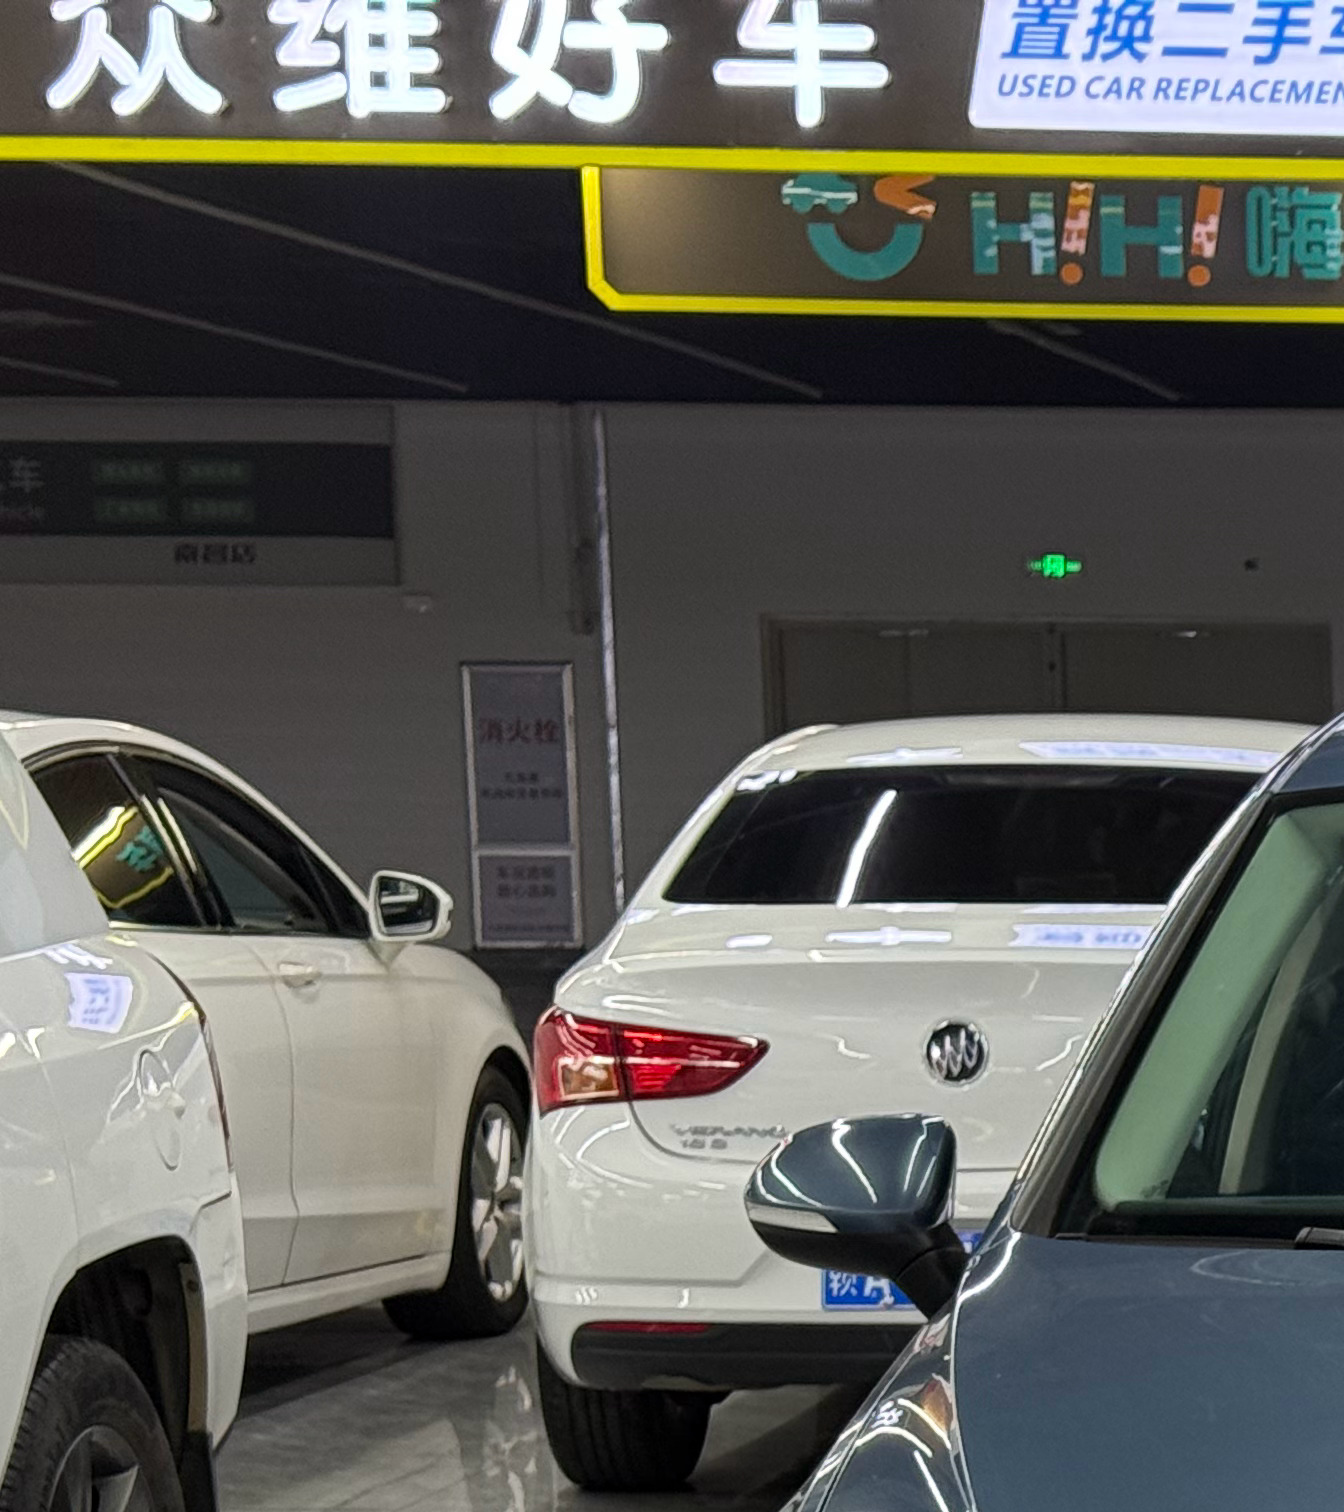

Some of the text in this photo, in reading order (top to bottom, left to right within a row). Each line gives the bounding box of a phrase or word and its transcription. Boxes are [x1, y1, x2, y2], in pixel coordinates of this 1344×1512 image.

[46, 0, 890, 128] 众维好车
[998, 73, 1076, 99] USED
[1084, 75, 1146, 101] CAR
[479, 717, 560, 746] 消火栓
